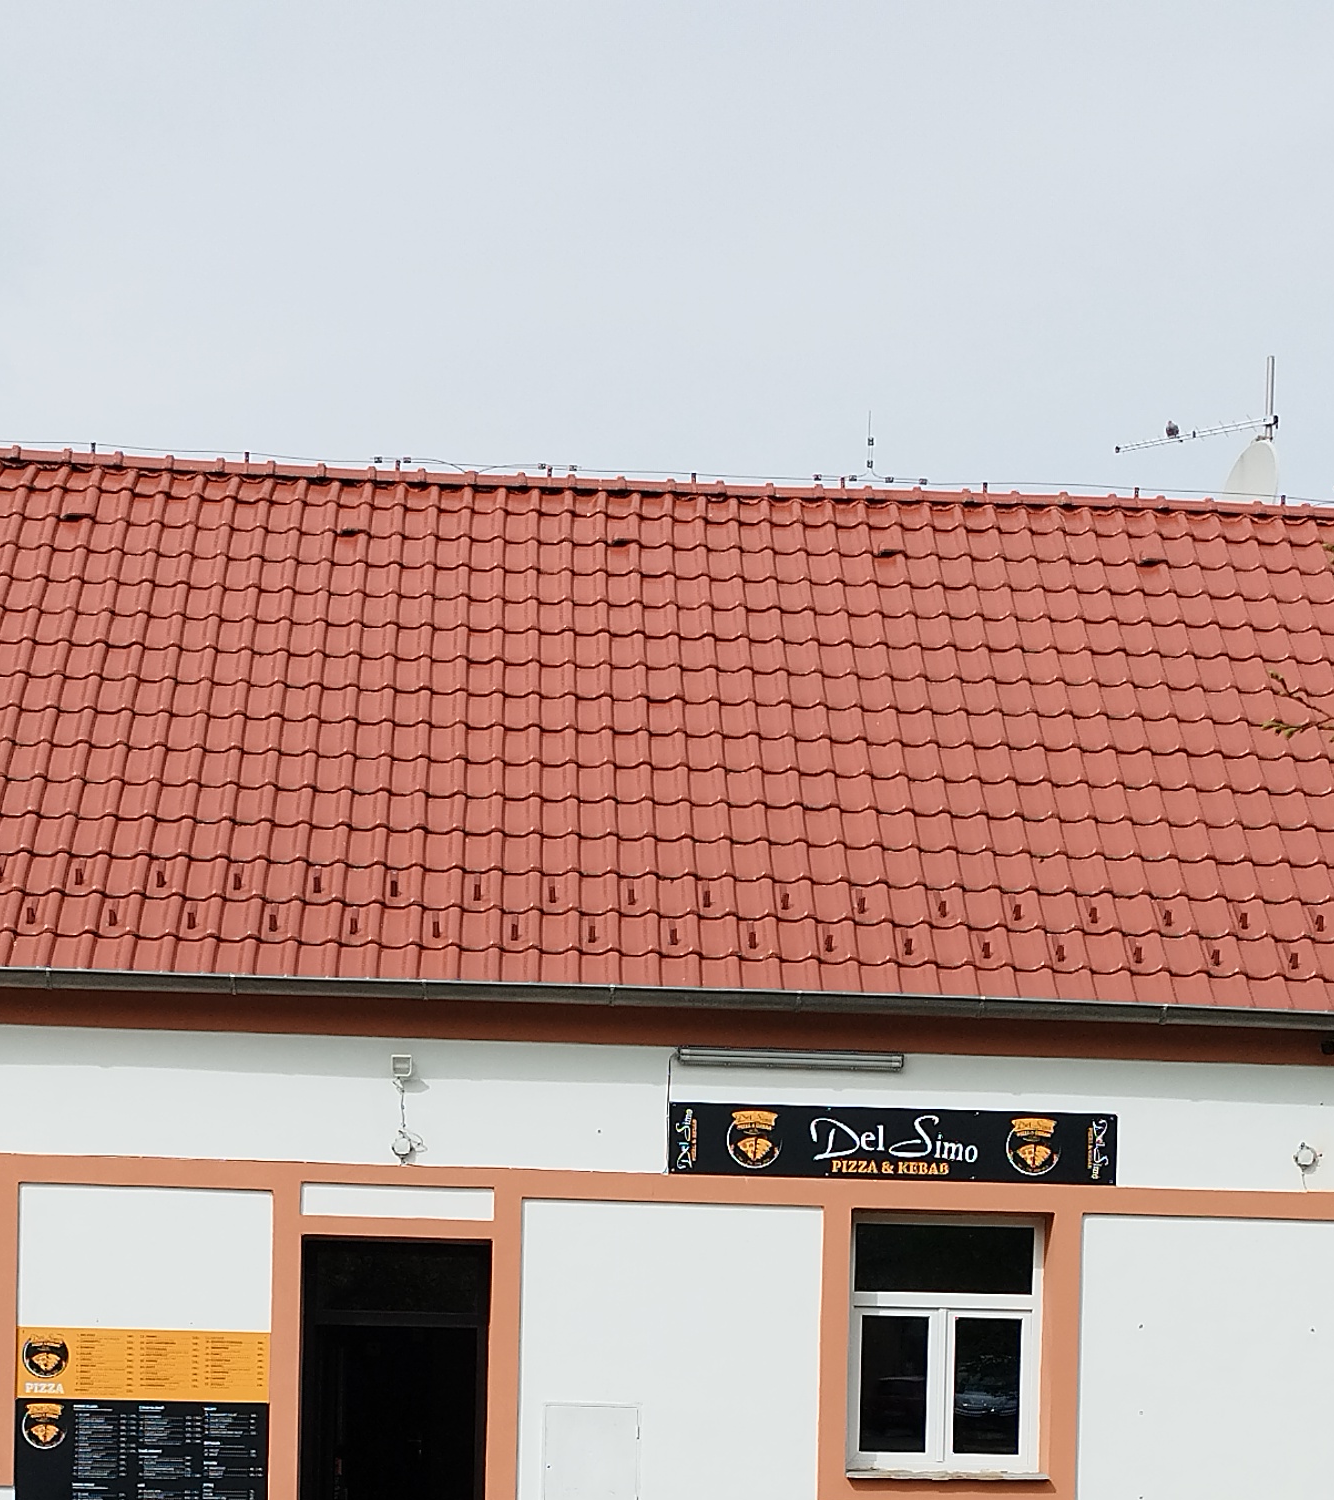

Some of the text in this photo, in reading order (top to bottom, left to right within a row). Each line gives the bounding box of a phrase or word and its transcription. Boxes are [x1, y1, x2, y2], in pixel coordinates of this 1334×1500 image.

[810, 1115, 978, 1163] Del Simo
[831, 1159, 949, 1175] PIZZA & KEBAB
[25, 1382, 64, 1394] PIZZA
